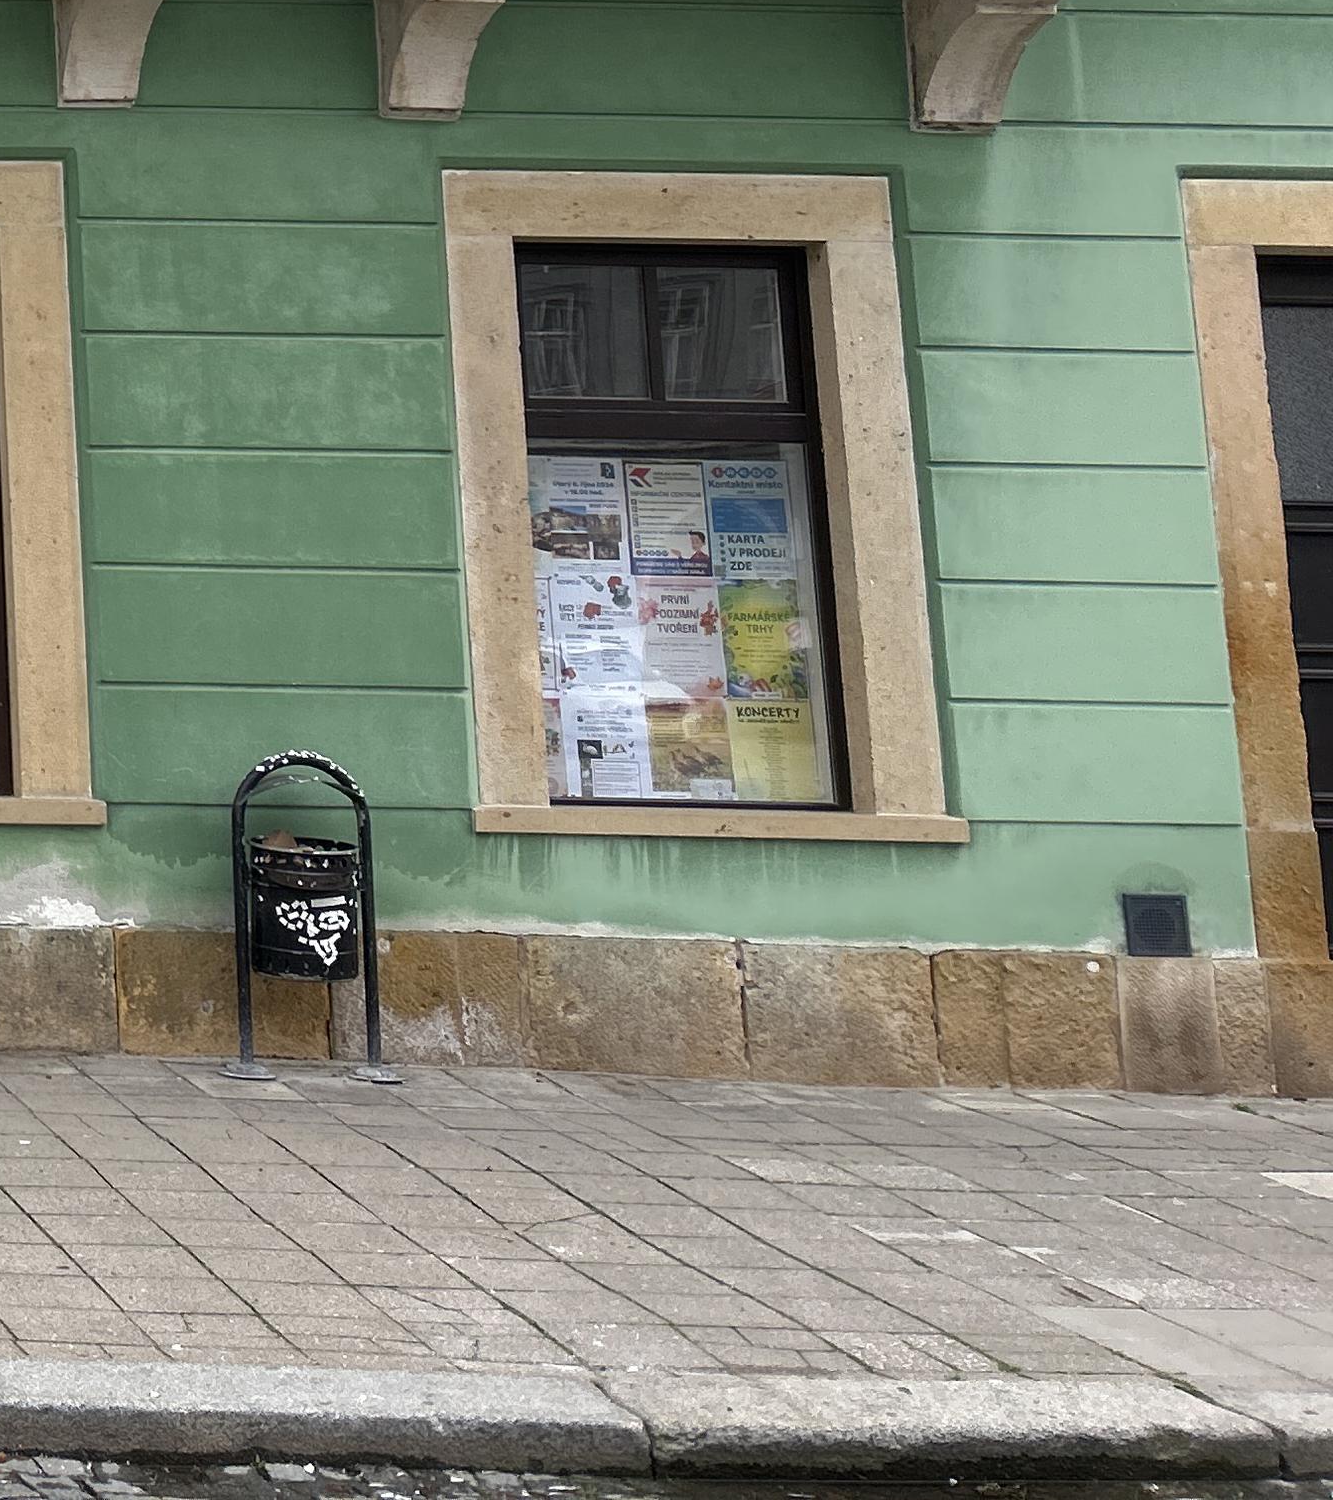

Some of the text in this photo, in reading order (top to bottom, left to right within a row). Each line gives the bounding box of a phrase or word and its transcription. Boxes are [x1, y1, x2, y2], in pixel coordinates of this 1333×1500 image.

[708, 480, 783, 489] Kontaktní místo
[727, 534, 765, 545] KARTA
[729, 548, 786, 558] V PRODEJI
[730, 561, 753, 571] ZDE
[661, 593, 690, 605] PRVNÍ
[728, 609, 790, 622] FARMÁŘSKÉ
[657, 621, 698, 634] TVOŘENÍ
[746, 624, 774, 634] TRHY
[736, 706, 800, 719] KONCERTY
